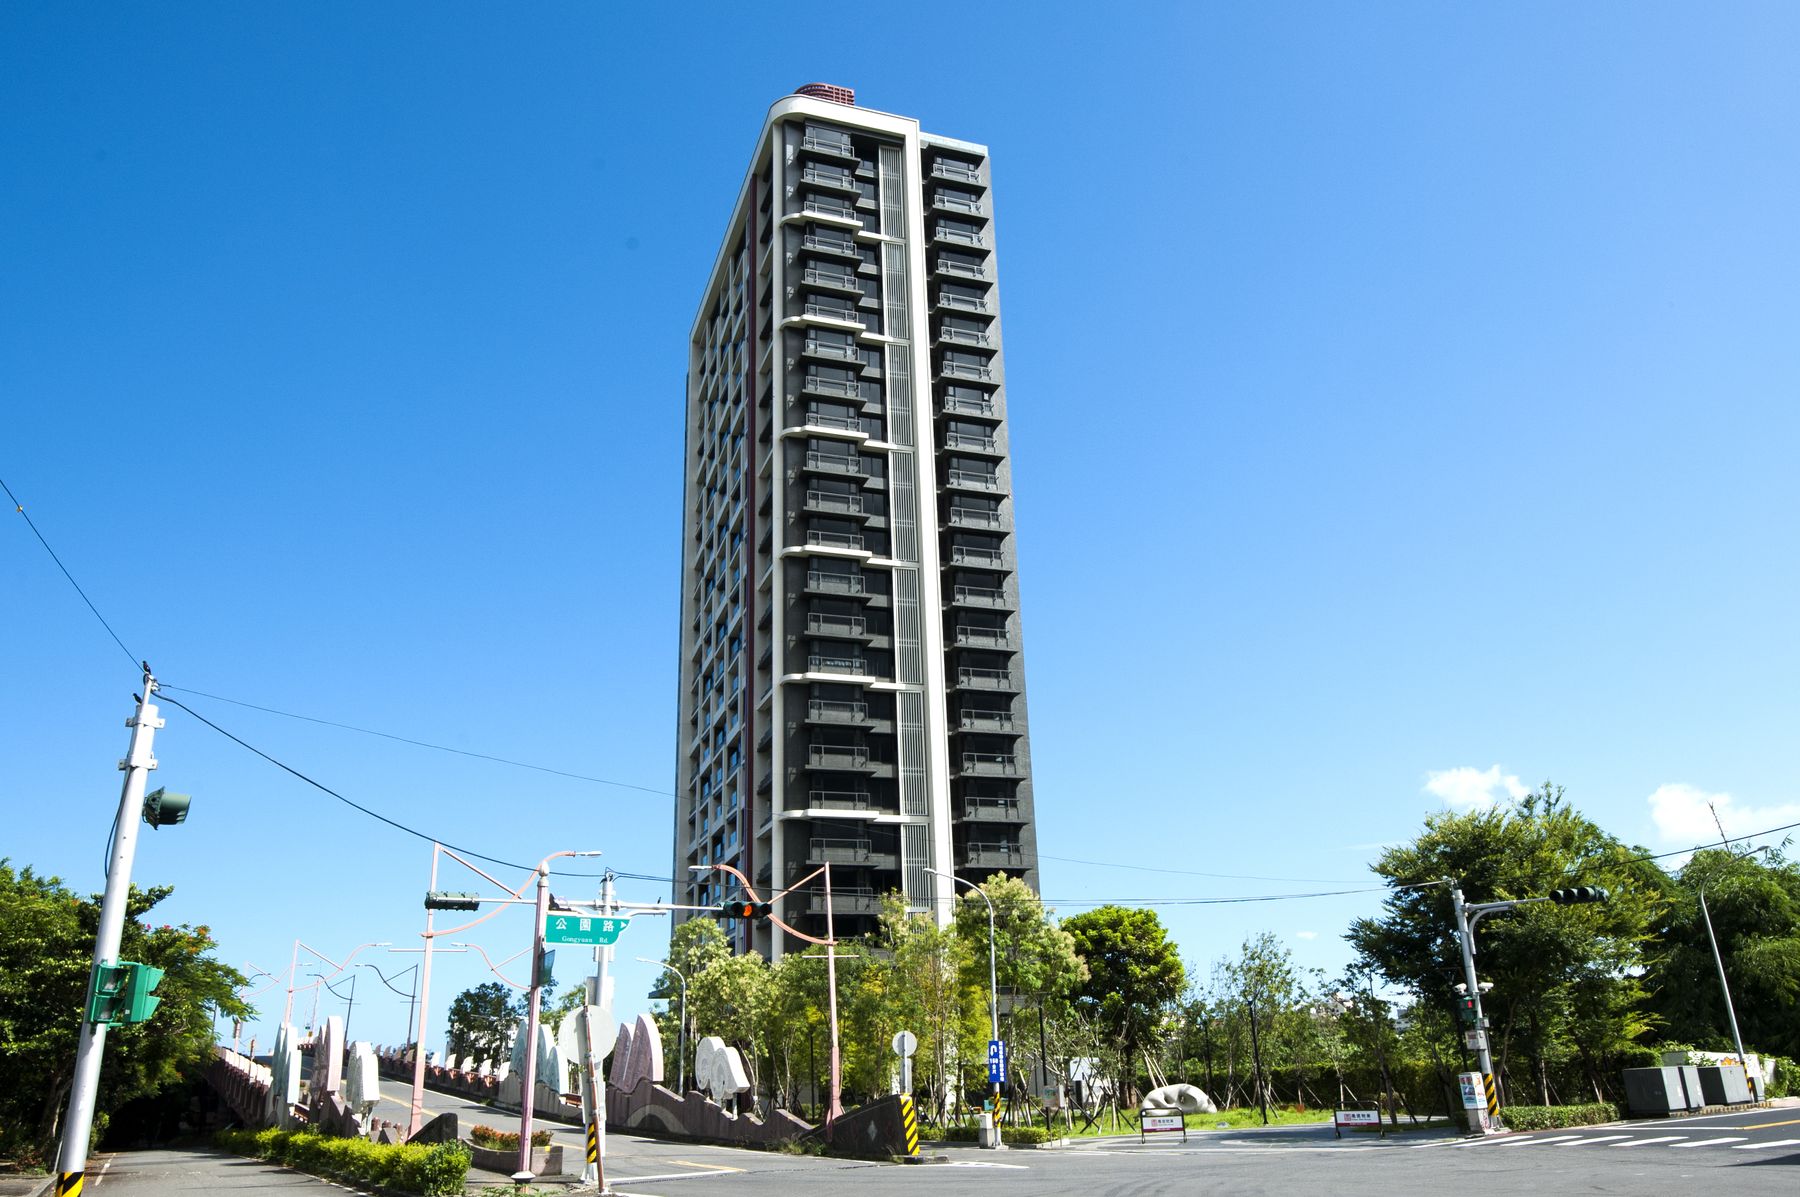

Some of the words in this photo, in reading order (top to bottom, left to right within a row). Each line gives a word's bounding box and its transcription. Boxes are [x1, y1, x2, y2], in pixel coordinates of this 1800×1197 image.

[555, 918, 614, 932] 公園路
[562, 936, 593, 944] Gongyuan
